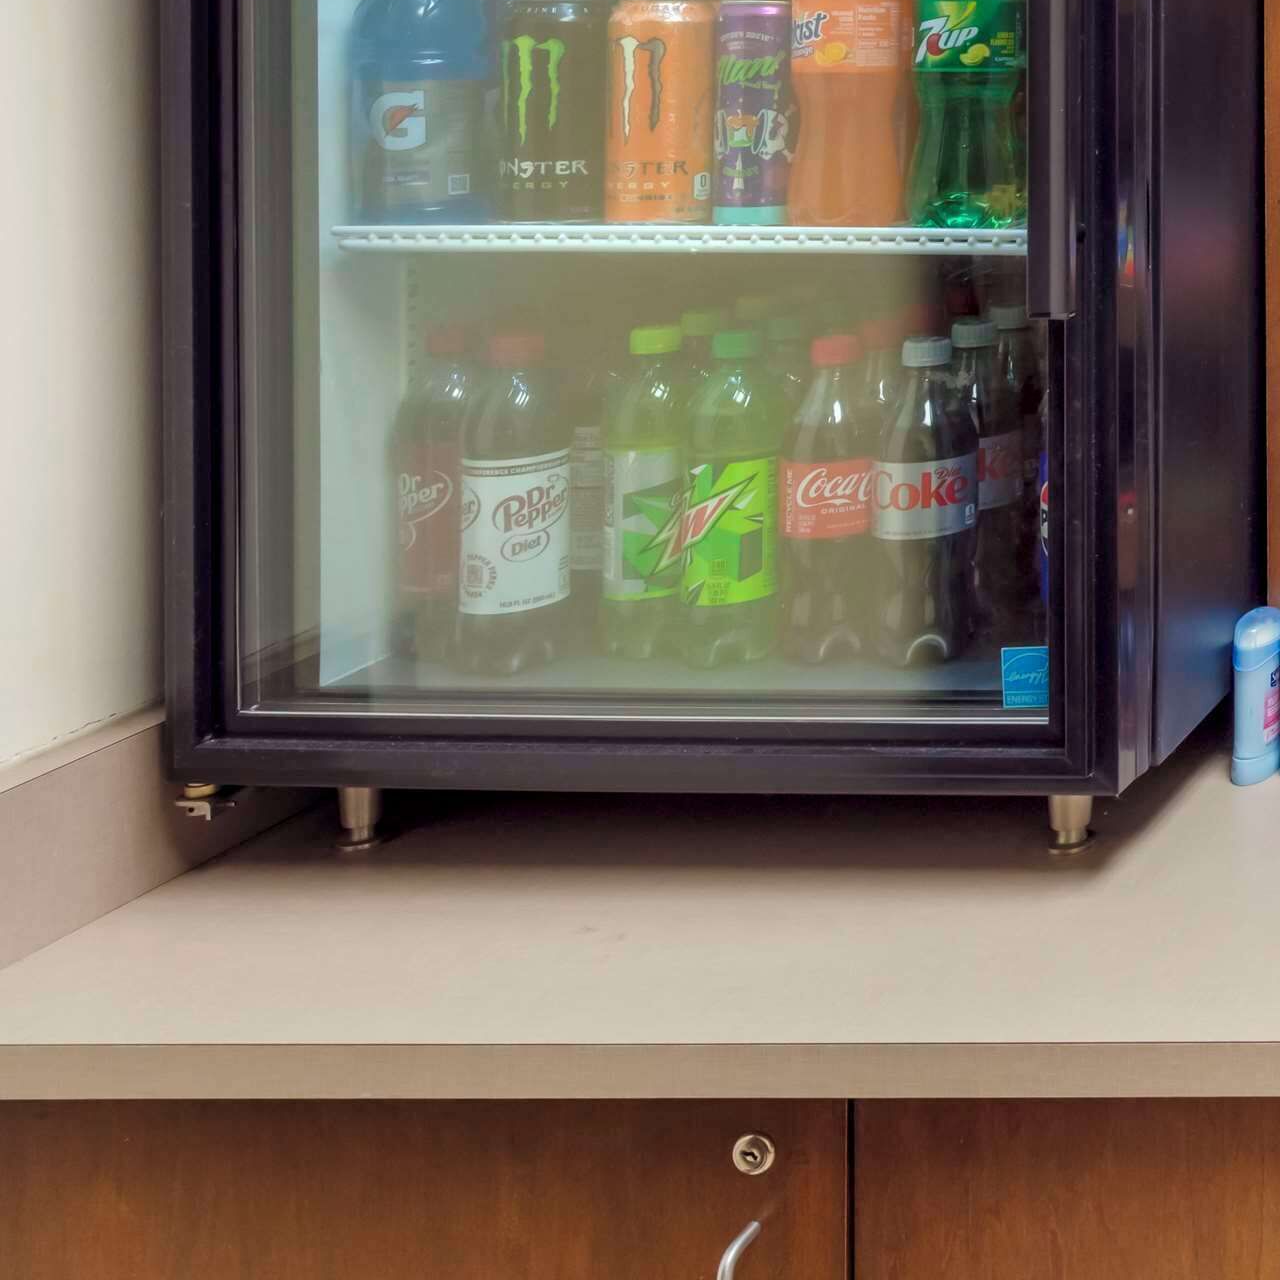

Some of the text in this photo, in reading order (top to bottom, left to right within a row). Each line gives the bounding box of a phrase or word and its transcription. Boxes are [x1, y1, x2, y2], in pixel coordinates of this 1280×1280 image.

[914, 14, 980, 65] 7UP
[369, 89, 427, 151] G
[502, 486, 570, 534] Pepper
[526, 483, 557, 510] Dr
[877, 470, 970, 512] Coke
[511, 535, 542, 557] Diet
